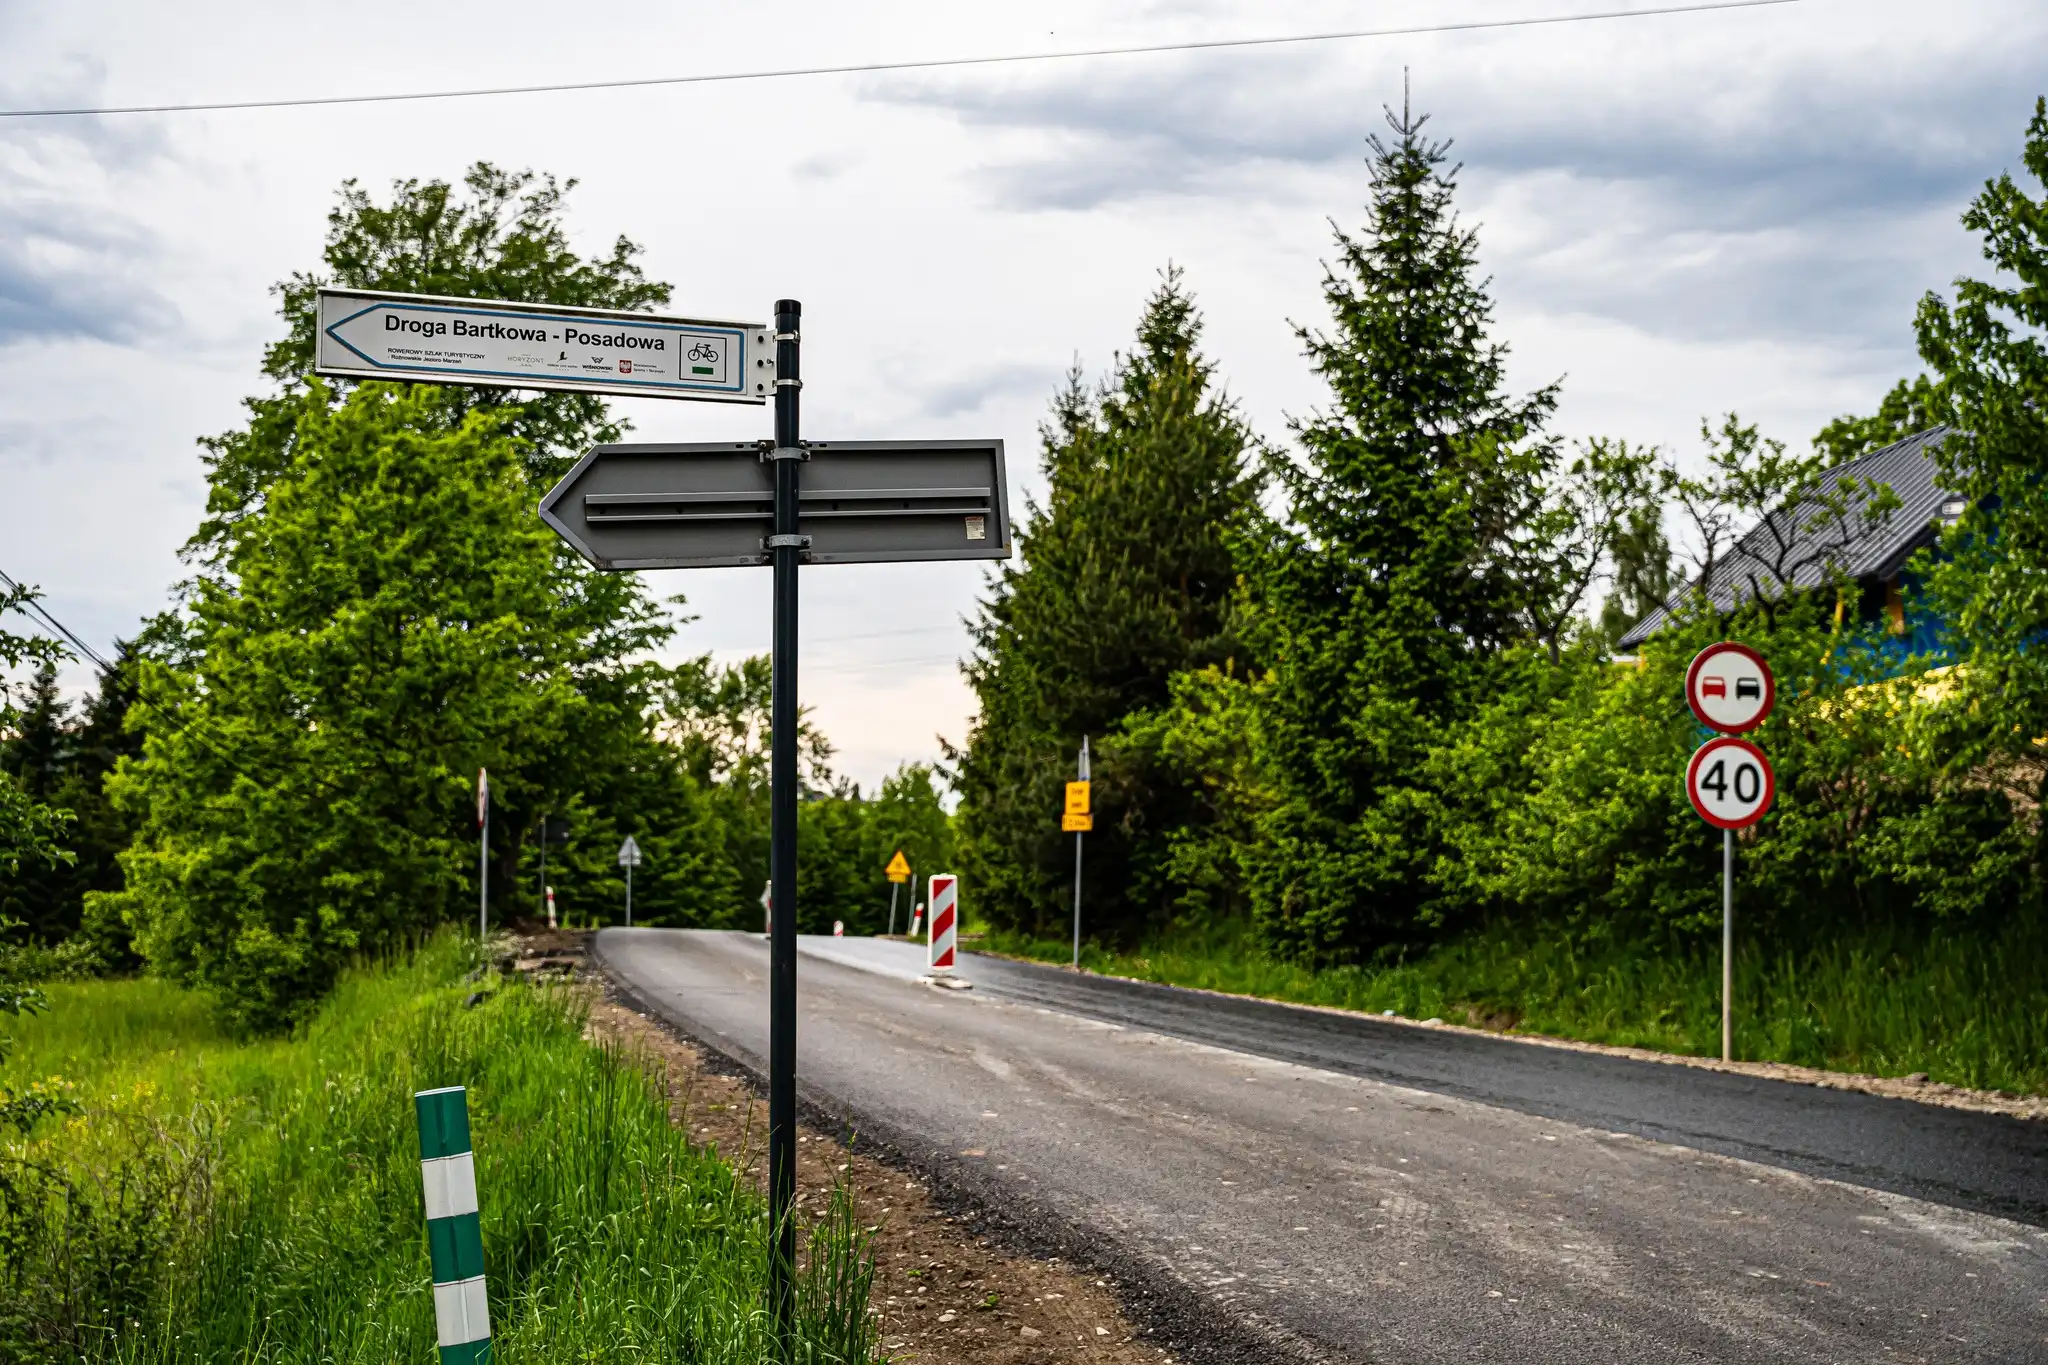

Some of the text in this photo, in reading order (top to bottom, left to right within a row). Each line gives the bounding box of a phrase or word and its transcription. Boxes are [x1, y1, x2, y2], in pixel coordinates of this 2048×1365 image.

[385, 314, 447, 338] Droga
[453, 320, 547, 342] Bartkowa
[565, 328, 665, 351] Posadowa
[387, 347, 423, 355] ROWEROWY
[444, 351, 485, 359] TURYSTYCZNY
[507, 356, 544, 364] HORYZONT
[1700, 759, 1761, 804] 40
